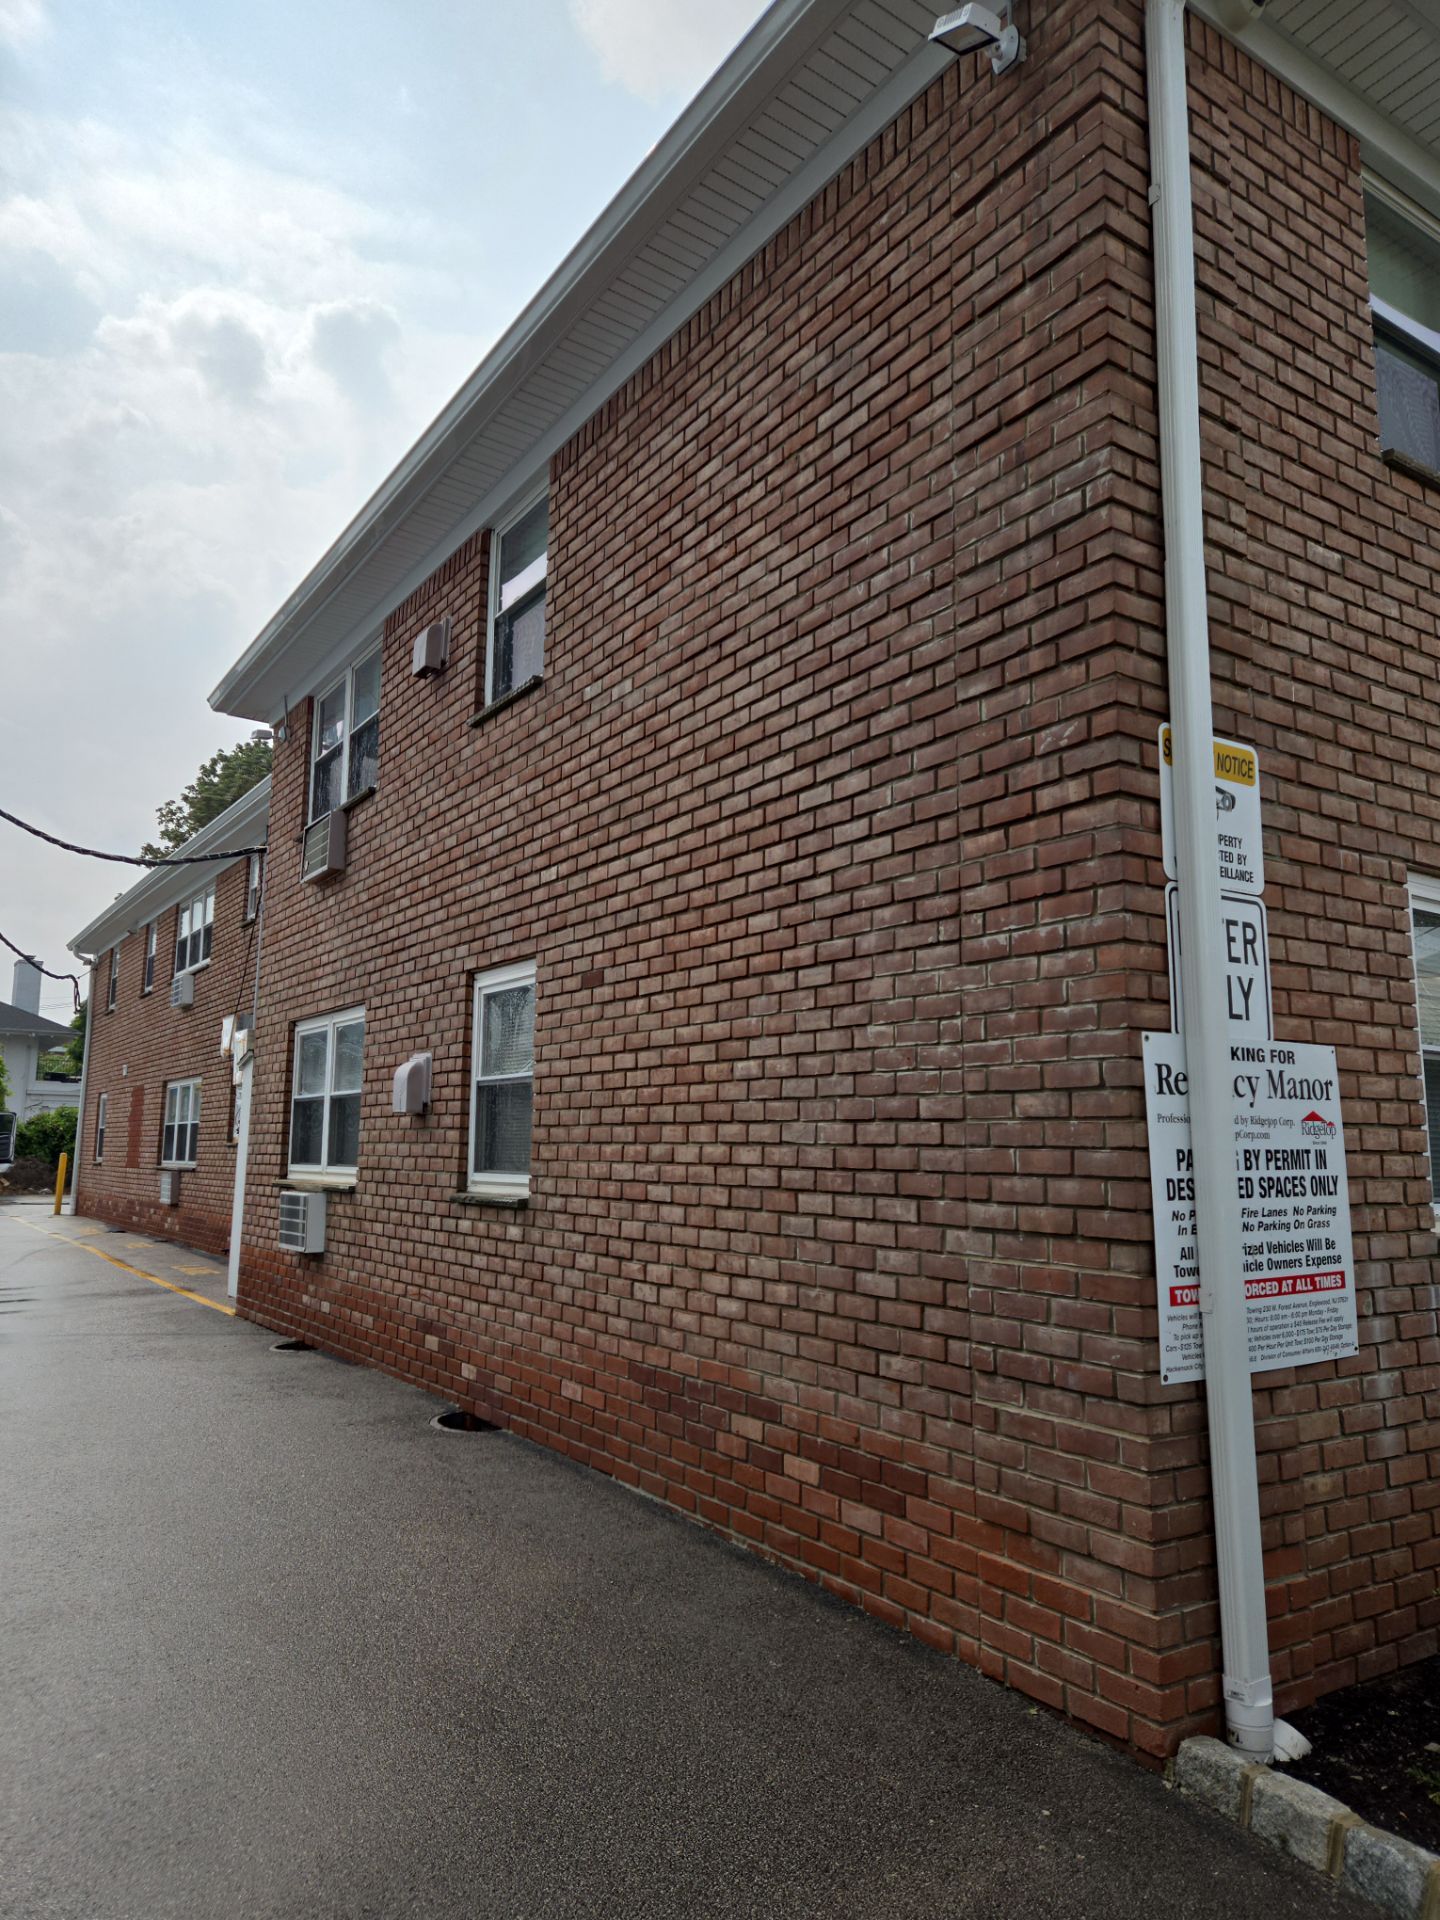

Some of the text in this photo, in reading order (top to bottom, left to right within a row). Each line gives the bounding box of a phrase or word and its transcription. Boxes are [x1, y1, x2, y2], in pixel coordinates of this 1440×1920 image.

[1217, 752, 1254, 780] NOTICE
[1218, 834, 1243, 850] PERTY
[1219, 850, 1248, 866] TED BY
[1220, 866, 1254, 884] EILLANCE
[1224, 917, 1259, 967] ER
[1226, 974, 1255, 1021] LY
[1230, 1046, 1296, 1065] KING FOR
[1155, 1062, 1333, 1109] Re cy Manor
[1241, 1115, 1249, 1128] by
[1243, 1148, 1261, 1171] BY
[1265, 1148, 1311, 1171] PERMIT
[1315, 1148, 1328, 1170] IN
[1166, 1174, 1339, 1201] DES ED SPACES ONLY
[1171, 1209, 1186, 1222] No
[1241, 1207, 1259, 1219] Fire
[1261, 1206, 1288, 1218] Lanes
[1293, 1205, 1304, 1217] No
[1306, 1203, 1337, 1217] Parking
[1177, 1224, 1187, 1236] In
[1242, 1221, 1255, 1233] No
[1257, 1219, 1291, 1233] Parking
[1293, 1218, 1305, 1230] On
[1307, 1217, 1331, 1229] Grass
[1180, 1246, 1194, 1261] All
[1266, 1239, 1304, 1255] Vehicles
[1306, 1237, 1323, 1252] Will
[1325, 1237, 1336, 1251] Be
[1267, 1256, 1303, 1271] Owners
[1305, 1253, 1342, 1269] Expense
[1245, 1281, 1279, 1296] ORCED
[1282, 1279, 1294, 1293] AT
[1296, 1277, 1313, 1292] ALL
[1315, 1274, 1342, 1289] TIMES
